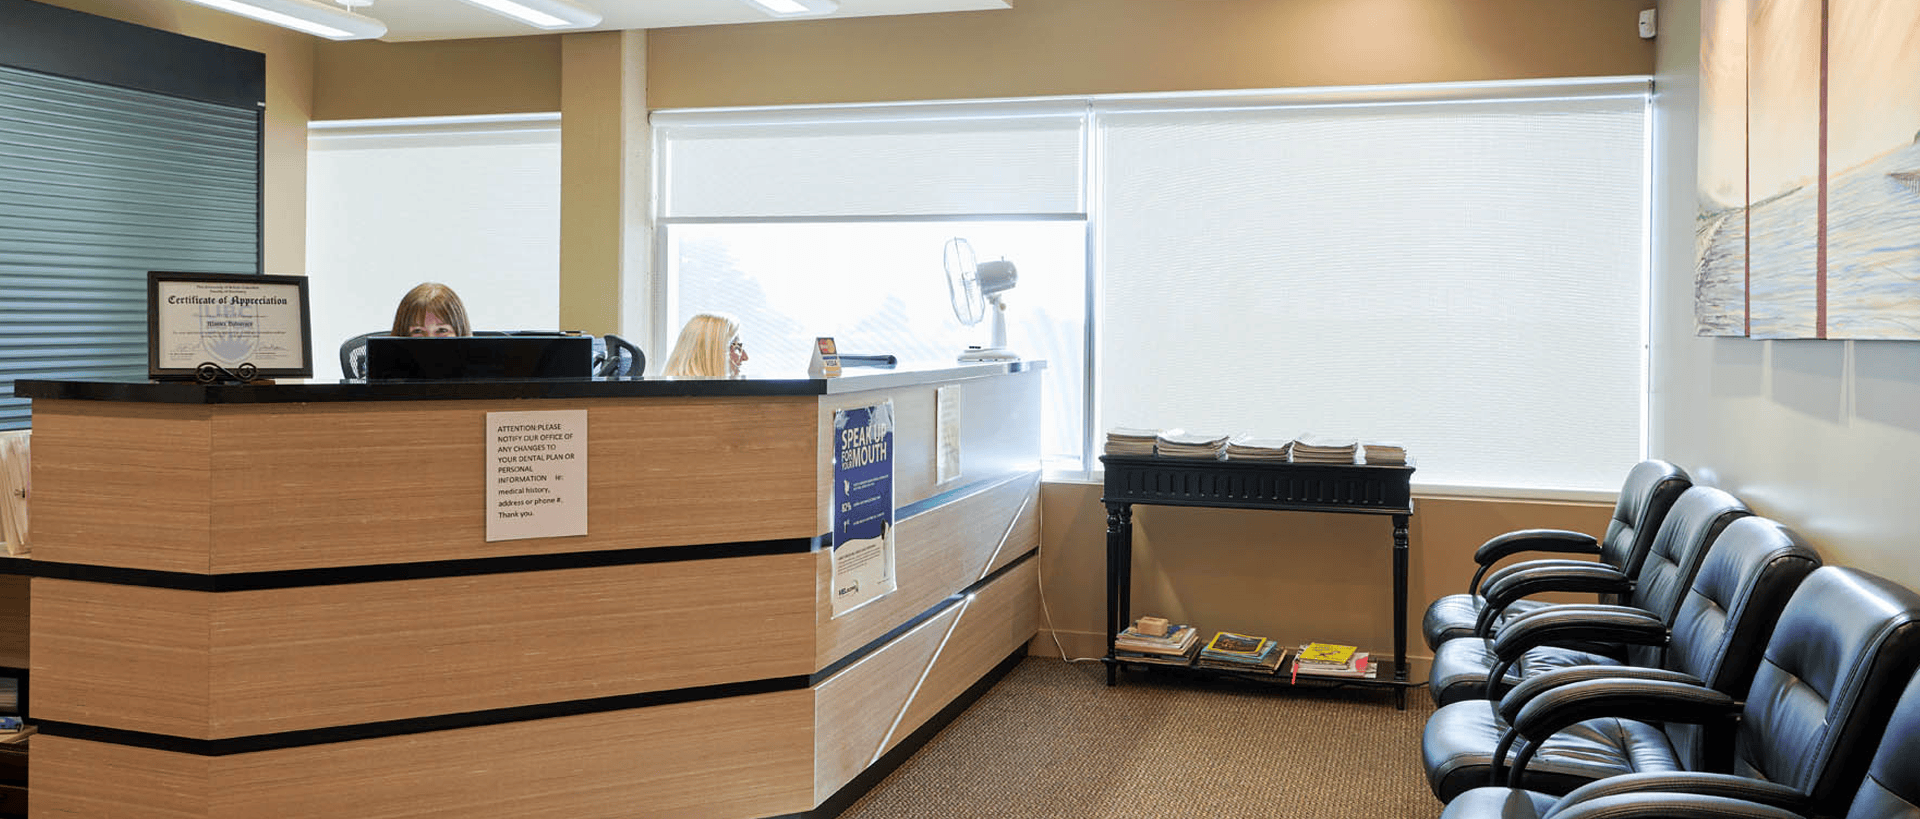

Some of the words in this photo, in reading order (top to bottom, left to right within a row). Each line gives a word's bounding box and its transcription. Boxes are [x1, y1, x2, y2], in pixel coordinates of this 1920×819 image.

[168, 295, 216, 305] Certificate
[218, 295, 228, 305] of
[230, 295, 288, 307] Appreciation
[537, 423, 562, 431] PLEASE
[539, 433, 563, 441] OFFICE
[841, 424, 873, 450] SPEAK
[873, 422, 887, 443] UP
[513, 444, 545, 452] CHANGES
[545, 453, 564, 461] PLAN
[841, 449, 853, 462] FOR
[852, 441, 887, 468] MOUTH
[498, 475, 547, 483] INFORMATION
[498, 487, 525, 495] medical
